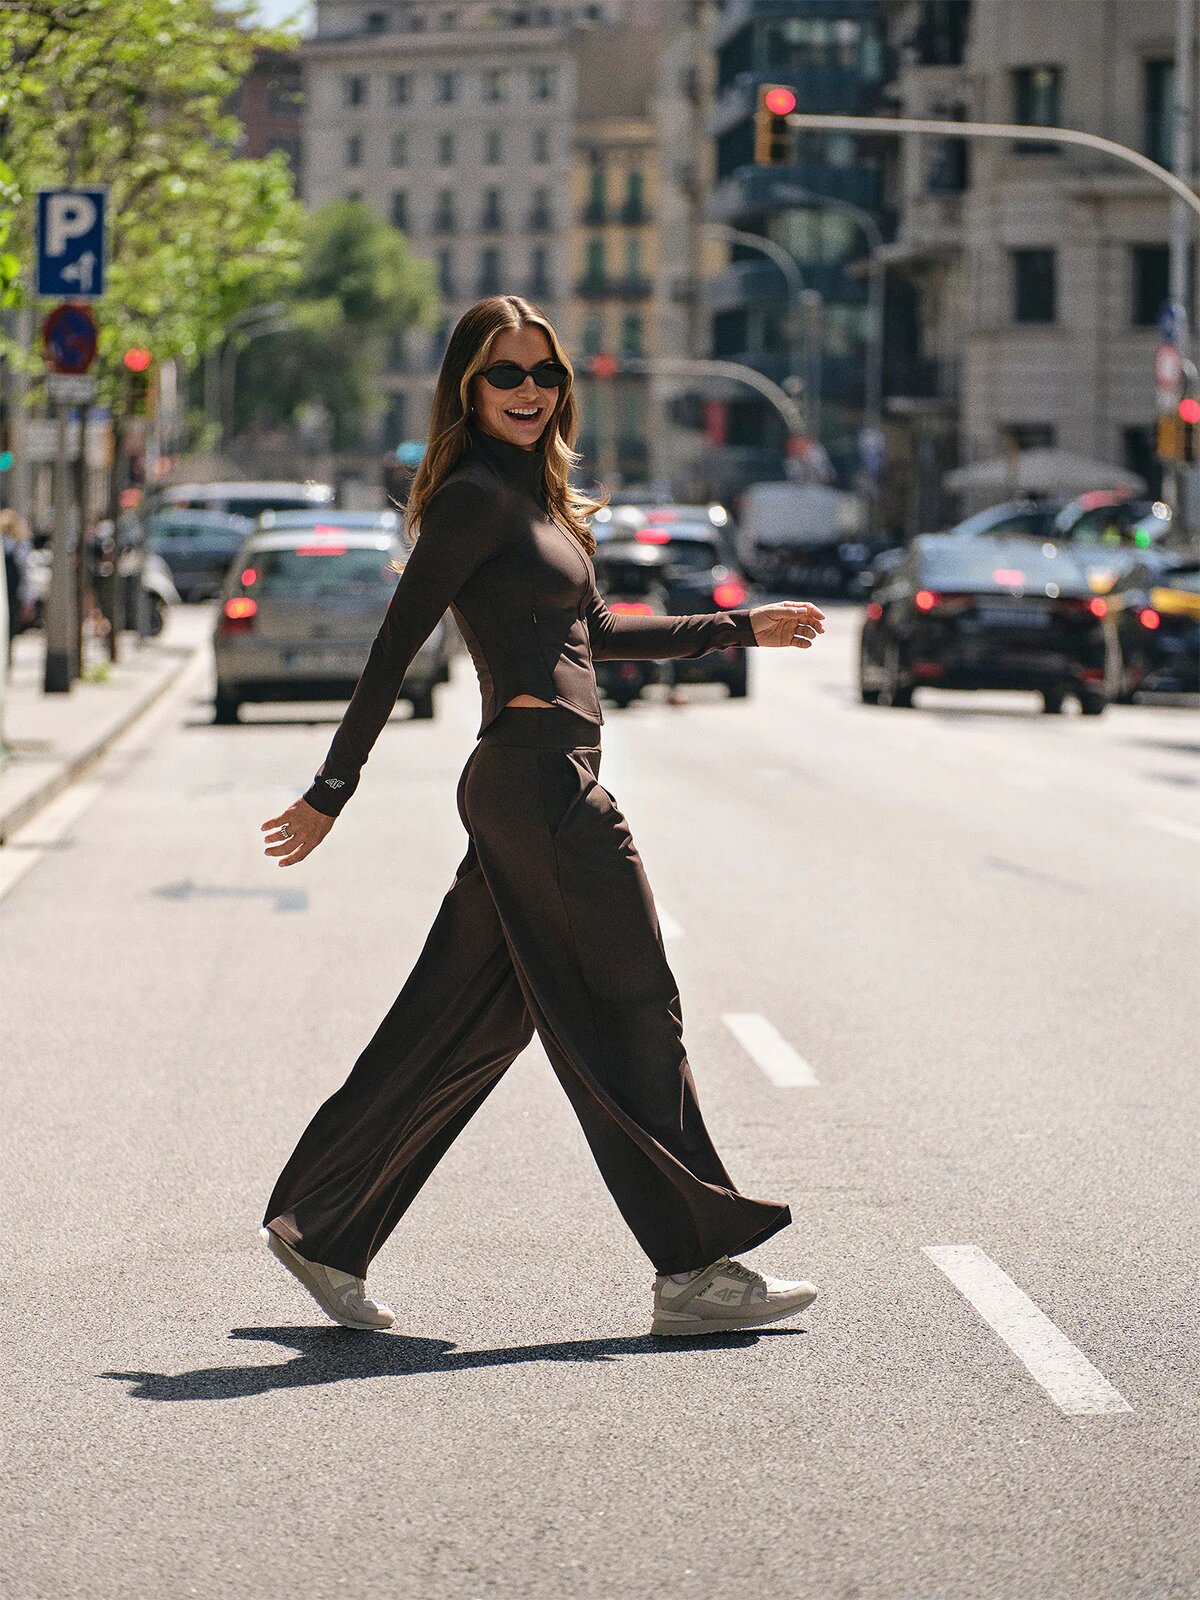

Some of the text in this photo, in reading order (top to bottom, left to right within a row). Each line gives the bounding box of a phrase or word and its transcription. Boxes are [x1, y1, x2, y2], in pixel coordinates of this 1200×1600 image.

[45, 194, 97, 257] P
[325, 778, 345, 790] 4F
[713, 1287, 743, 1302] 4F
